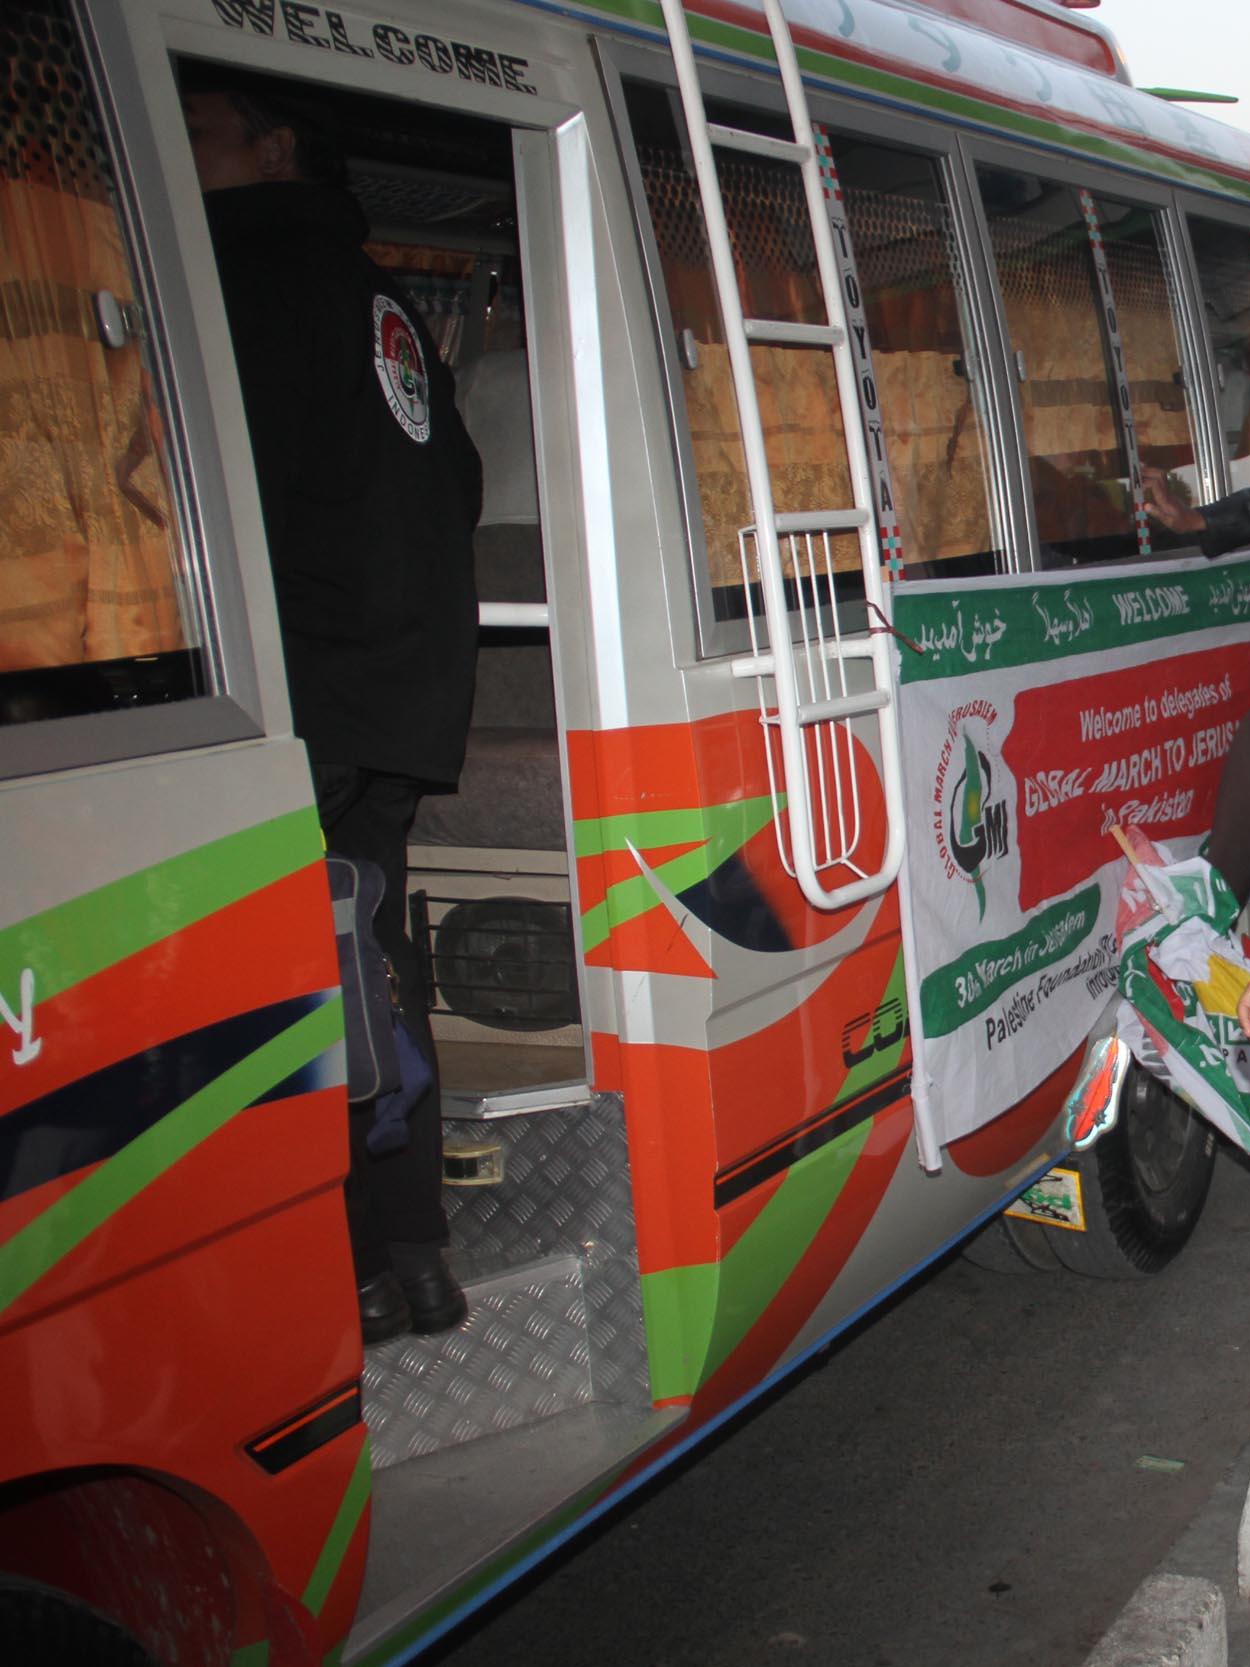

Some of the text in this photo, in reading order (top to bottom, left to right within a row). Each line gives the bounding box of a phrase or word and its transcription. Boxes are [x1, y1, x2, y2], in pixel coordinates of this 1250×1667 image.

[212, 0, 538, 96] WELCOME
[831, 216, 893, 512] TOYOTA
[1112, 584, 1191, 625] WELCOME
[1080, 672, 1233, 743] Welcome to delegates of
[1024, 719, 1241, 817] GLOBAL MARCH TO JERUS
[1100, 788, 1195, 837] in Pakistan
[985, 988, 1036, 1051] Palestine
